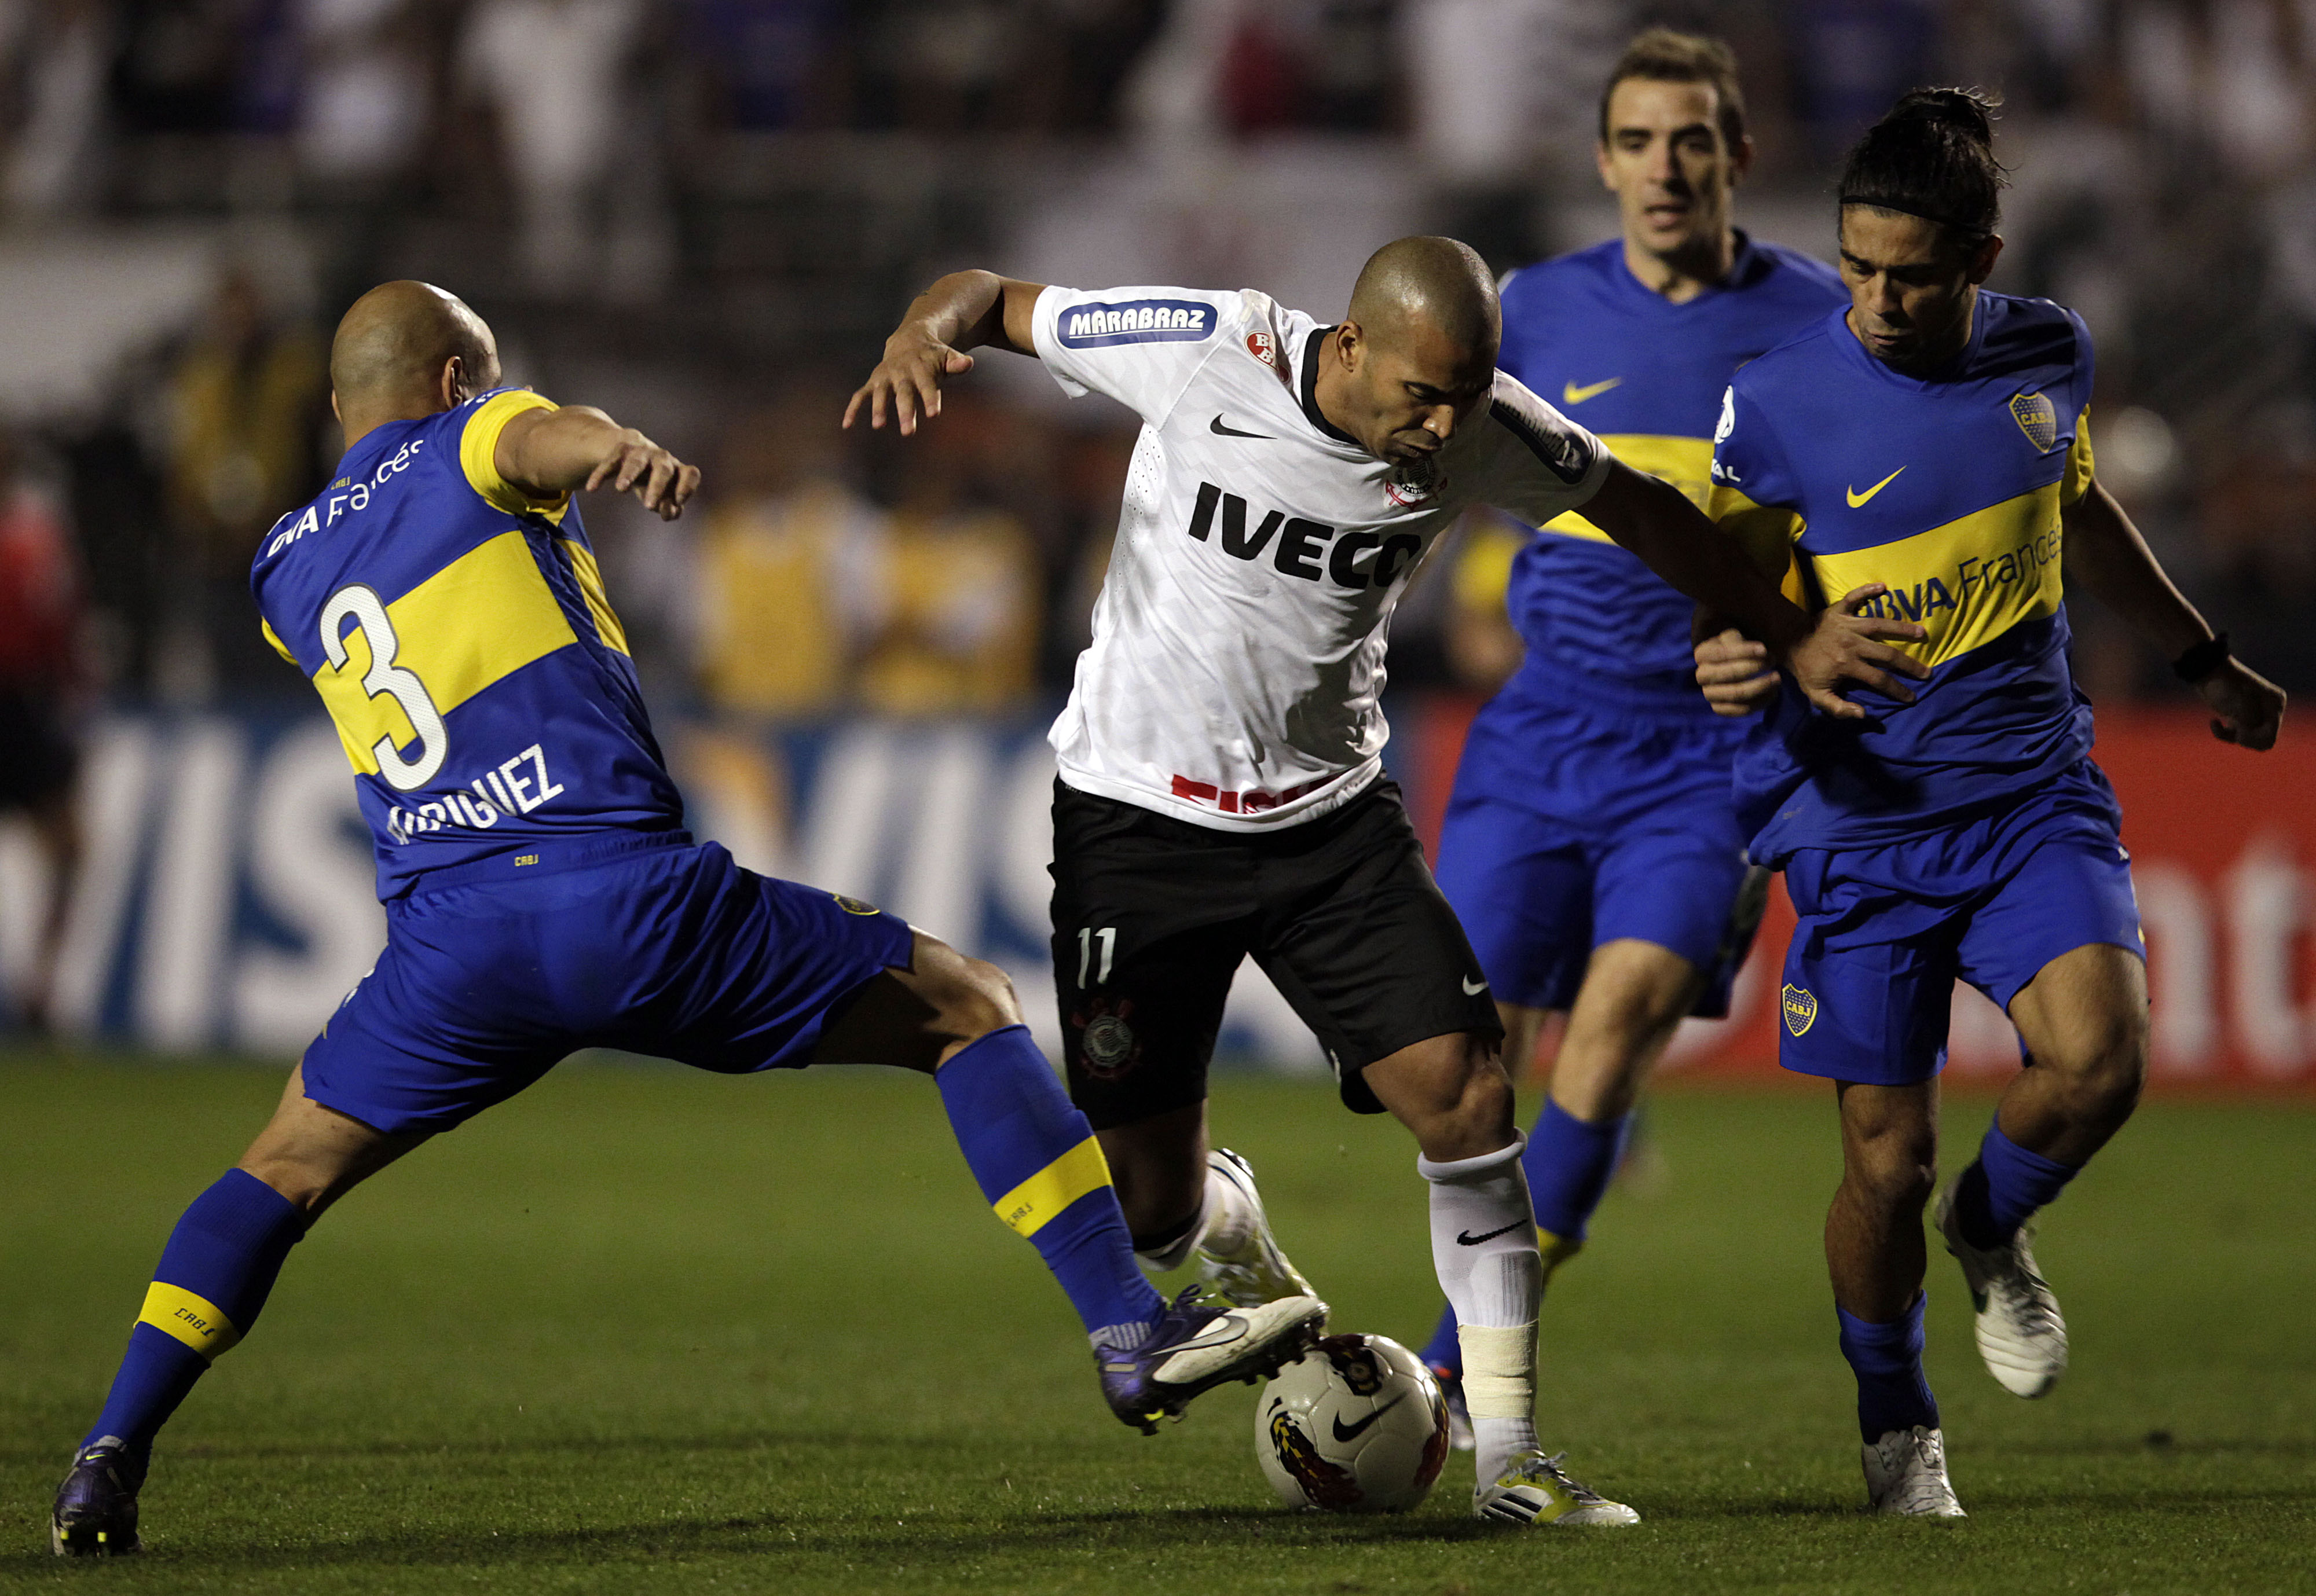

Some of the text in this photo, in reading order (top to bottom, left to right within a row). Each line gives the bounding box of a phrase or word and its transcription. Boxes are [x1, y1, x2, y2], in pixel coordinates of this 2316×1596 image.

[1069, 307, 1205, 336] MARABRAZ
[1188, 481, 1422, 589] IVECO
[319, 581, 450, 794] 3
[514, 854, 539, 867] CABJ
[1077, 927, 1117, 990] 11
[1786, 1000, 1812, 1017] CABJ
[174, 1308, 215, 1337] CABJ
